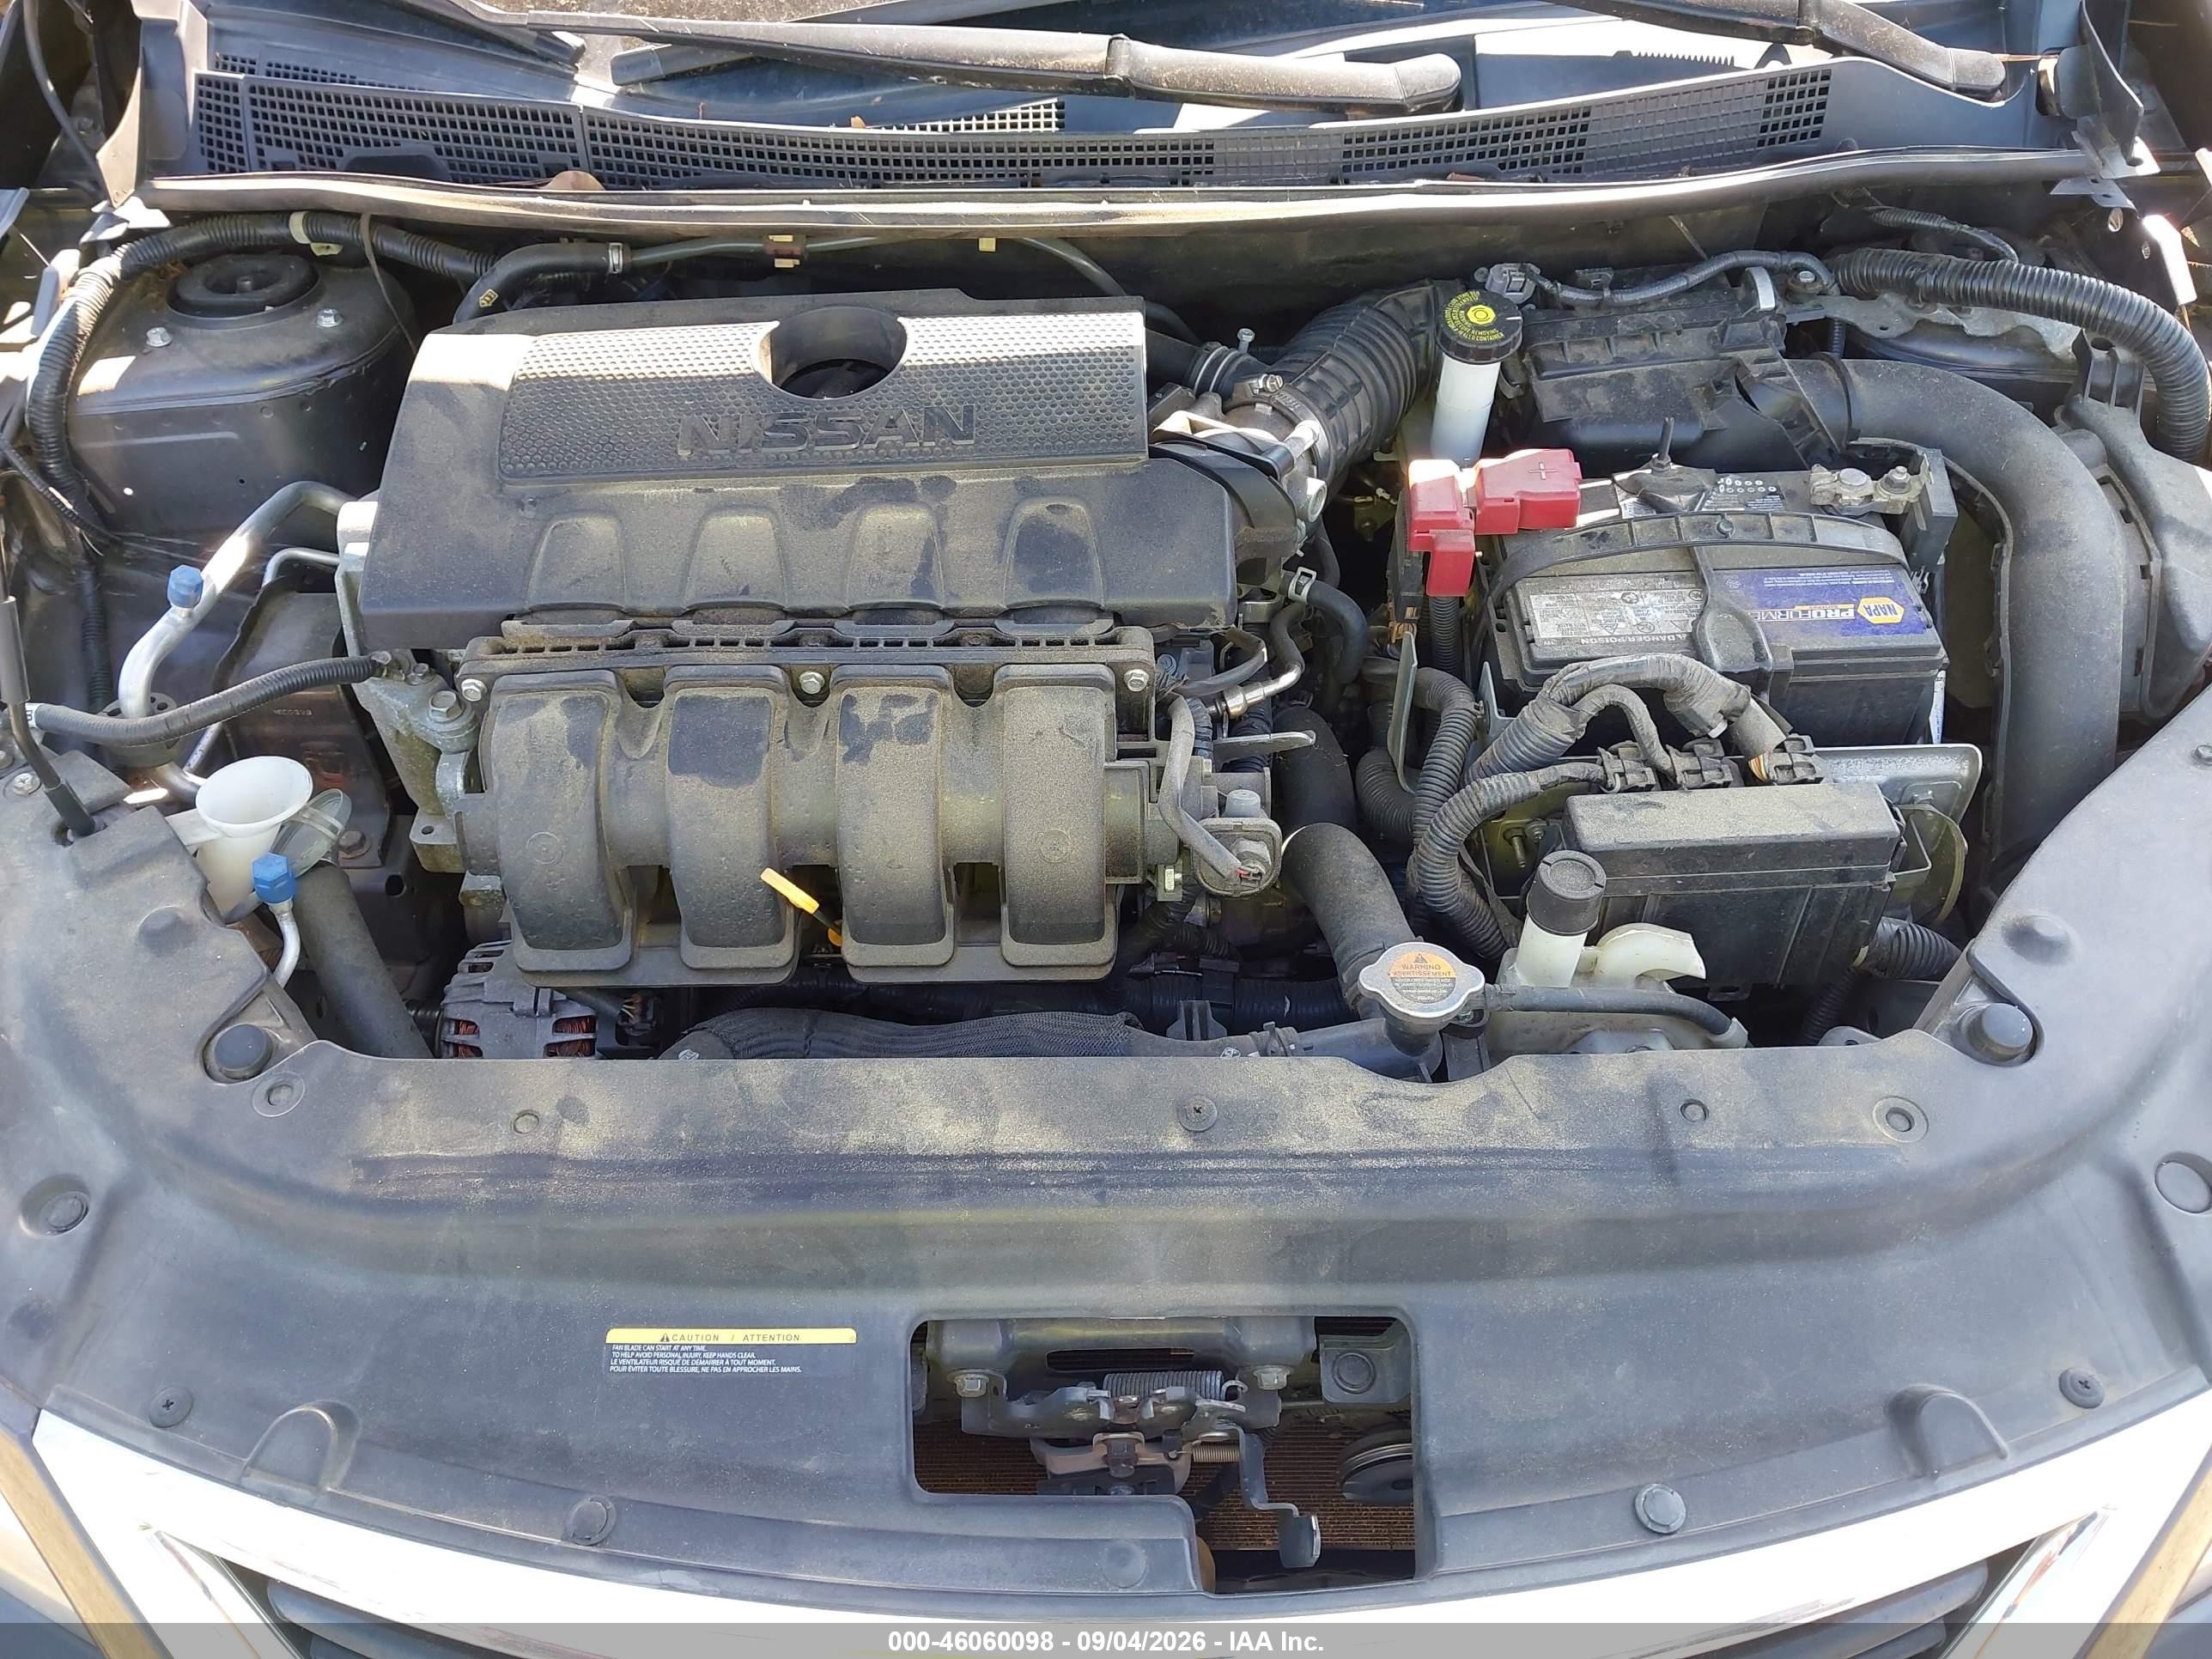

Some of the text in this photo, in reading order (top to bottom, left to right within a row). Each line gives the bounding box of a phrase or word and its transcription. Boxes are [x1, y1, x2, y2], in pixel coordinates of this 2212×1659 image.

[678, 404, 975, 456] NISSAN
[1747, 608, 1855, 621] PROFORME
[1863, 603, 1897, 616] NAPA
